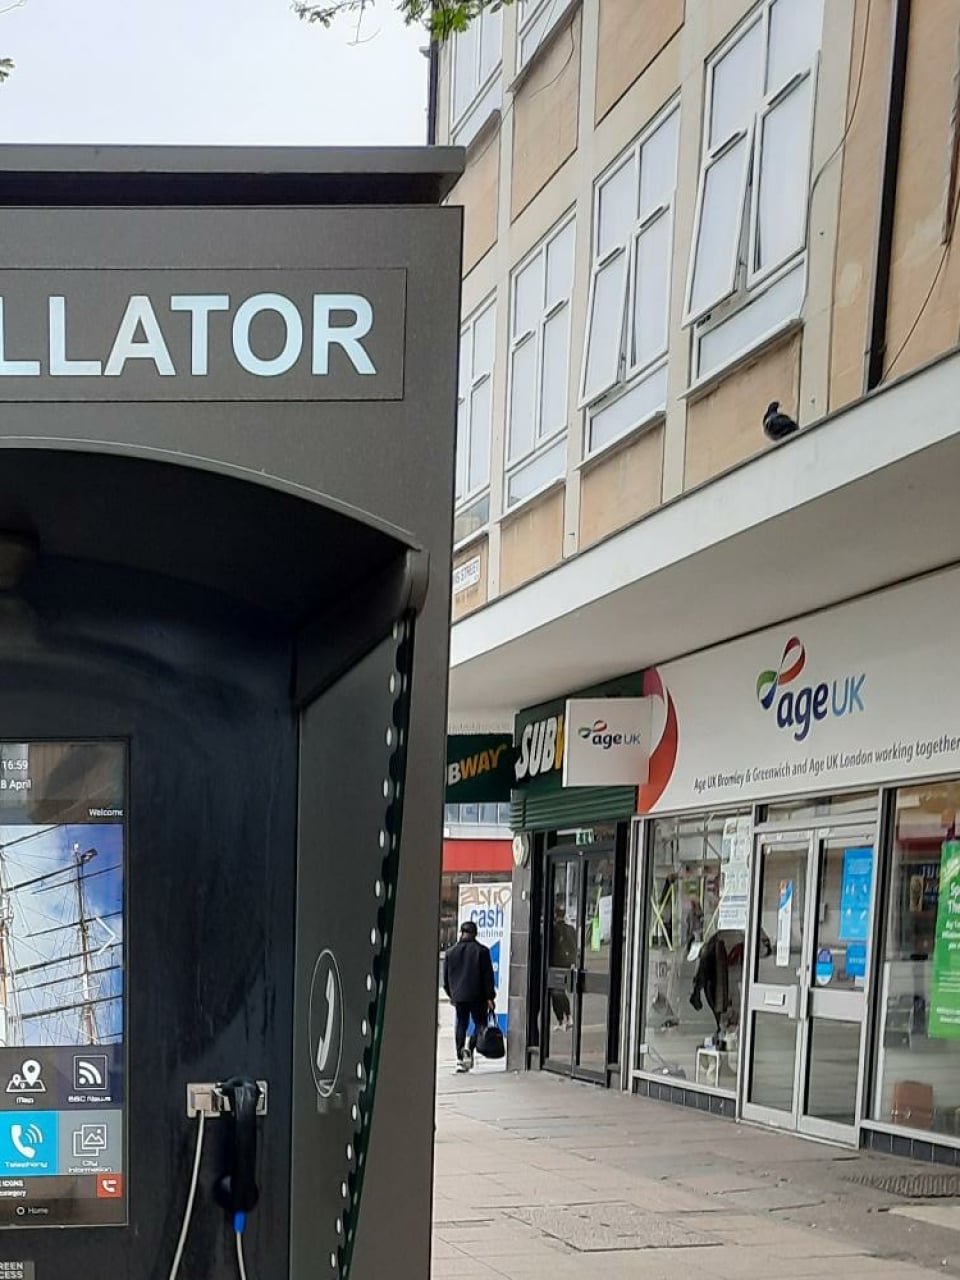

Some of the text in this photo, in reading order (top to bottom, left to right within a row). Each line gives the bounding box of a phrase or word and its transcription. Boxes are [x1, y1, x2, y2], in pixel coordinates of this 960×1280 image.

[776, 673, 866, 741] age UK
[592, 732, 641, 749] age UK
[2, 759, 28, 771] 16:59
[693, 734, 960, 793] Age UK Bromley & Greenwich and Age UK London working together
[9, 778, 31, 790] April
[89, 808, 123, 817] Welcome
[470, 905, 504, 928] cash
[16, 1096, 34, 1104] Map
[5, 1161, 48, 1169] Telephony
